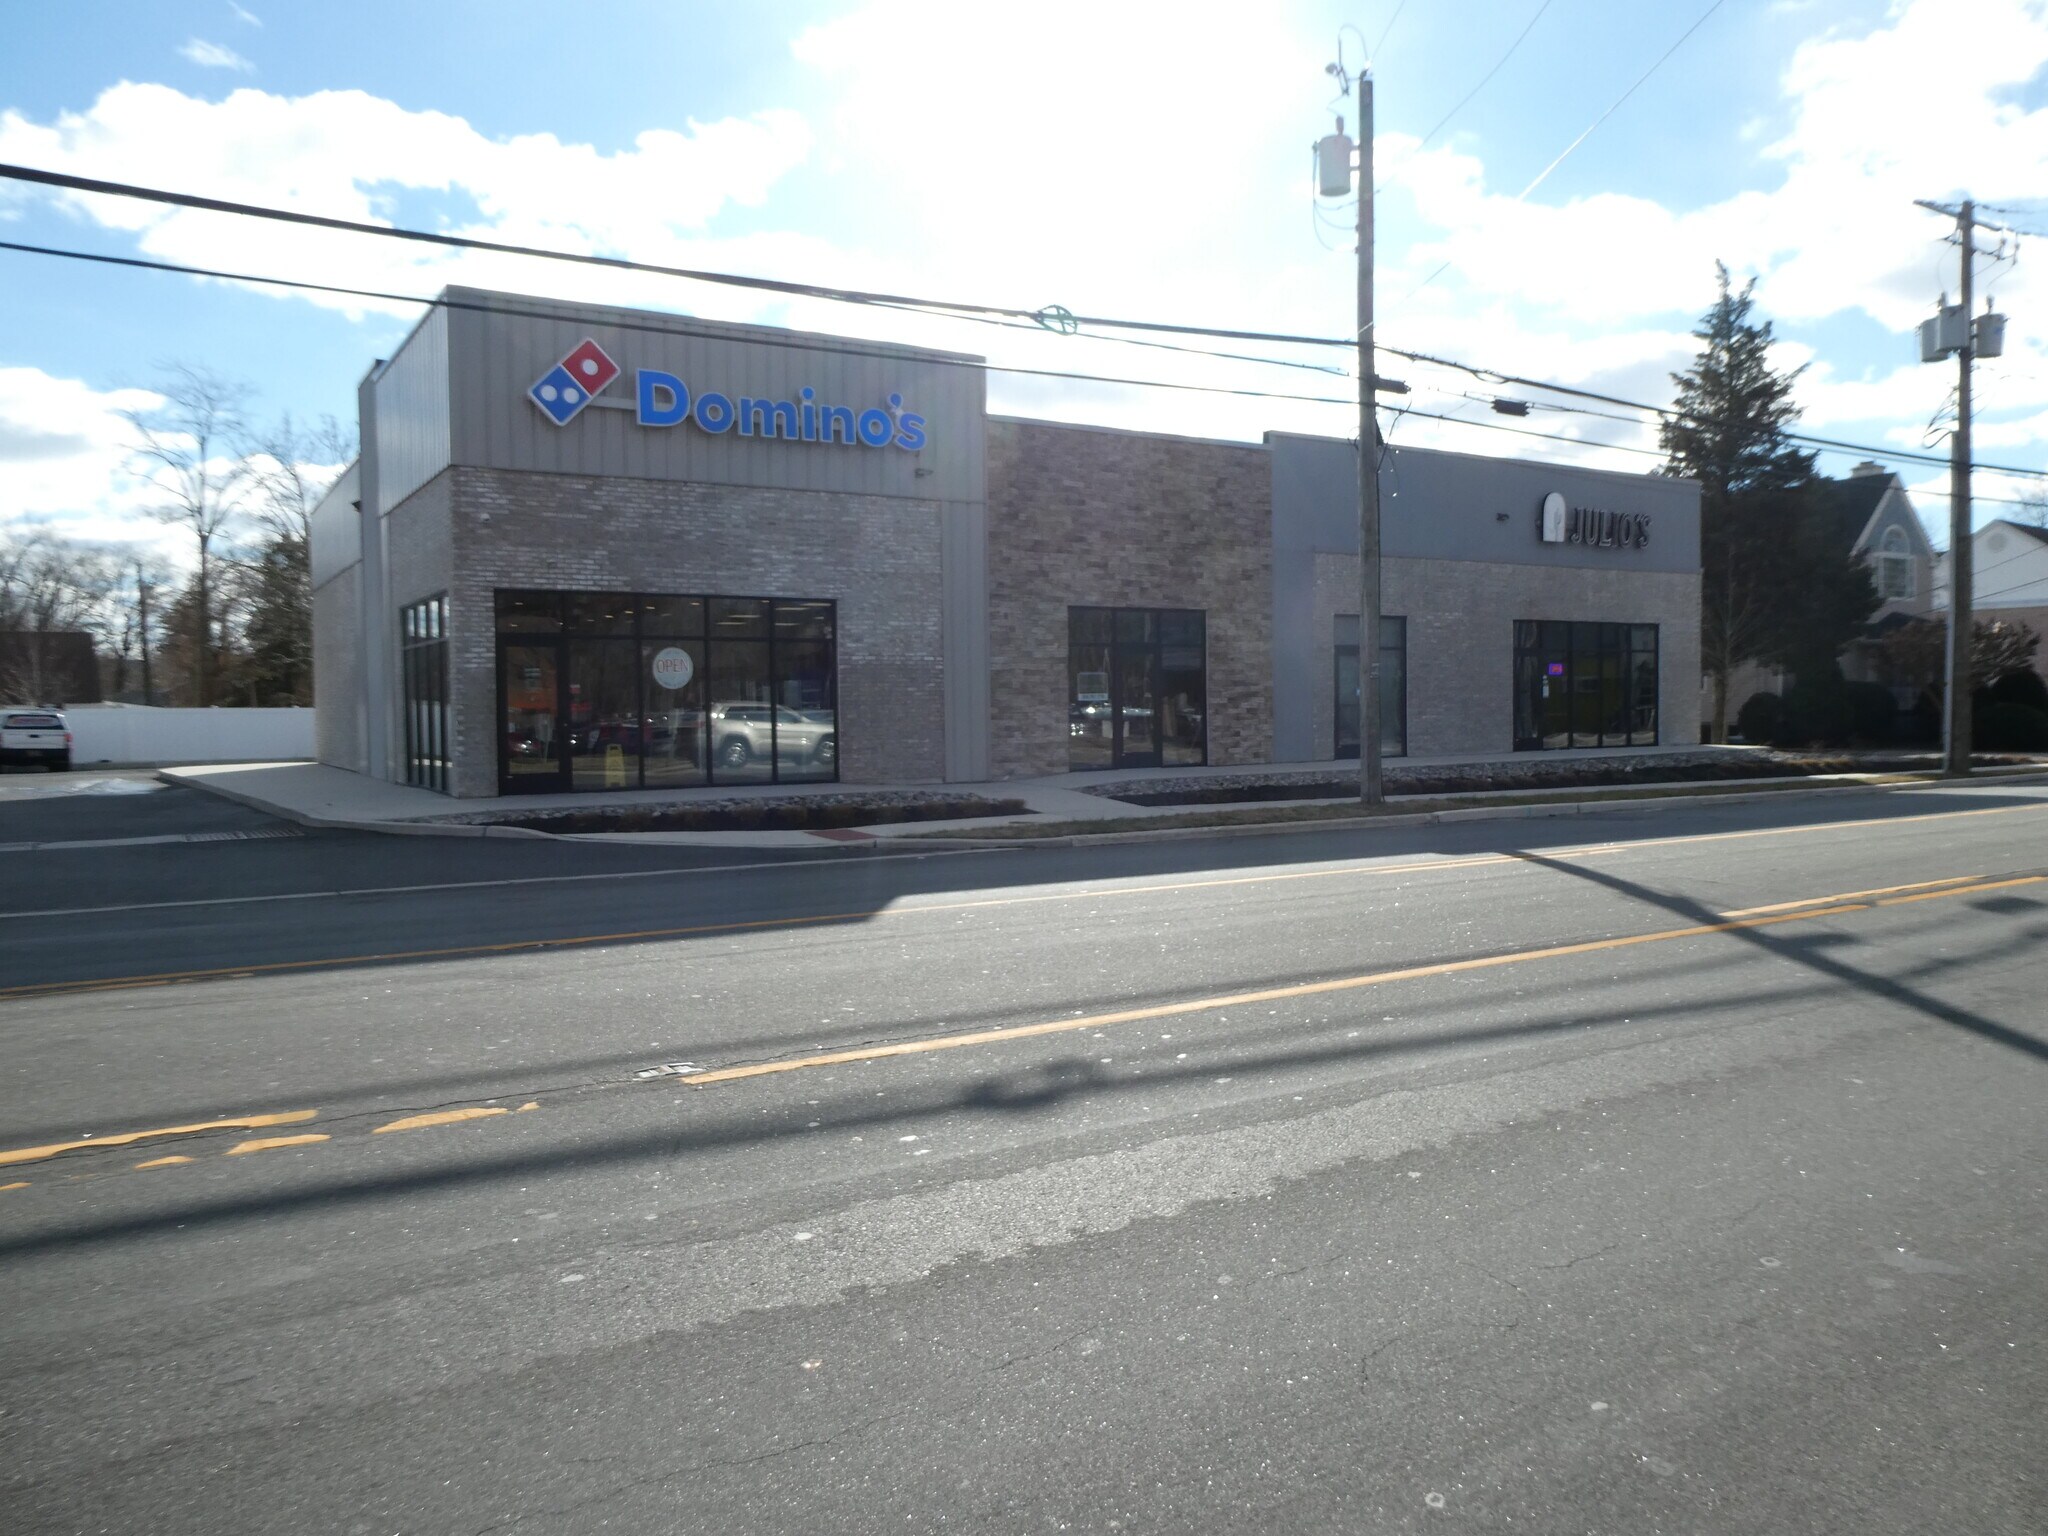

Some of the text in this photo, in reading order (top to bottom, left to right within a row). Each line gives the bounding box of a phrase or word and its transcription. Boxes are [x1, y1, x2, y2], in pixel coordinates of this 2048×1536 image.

[635, 367, 928, 452] Domino's
[1570, 506, 1653, 549] JULIO'S
[656, 657, 689, 674] OPEN
